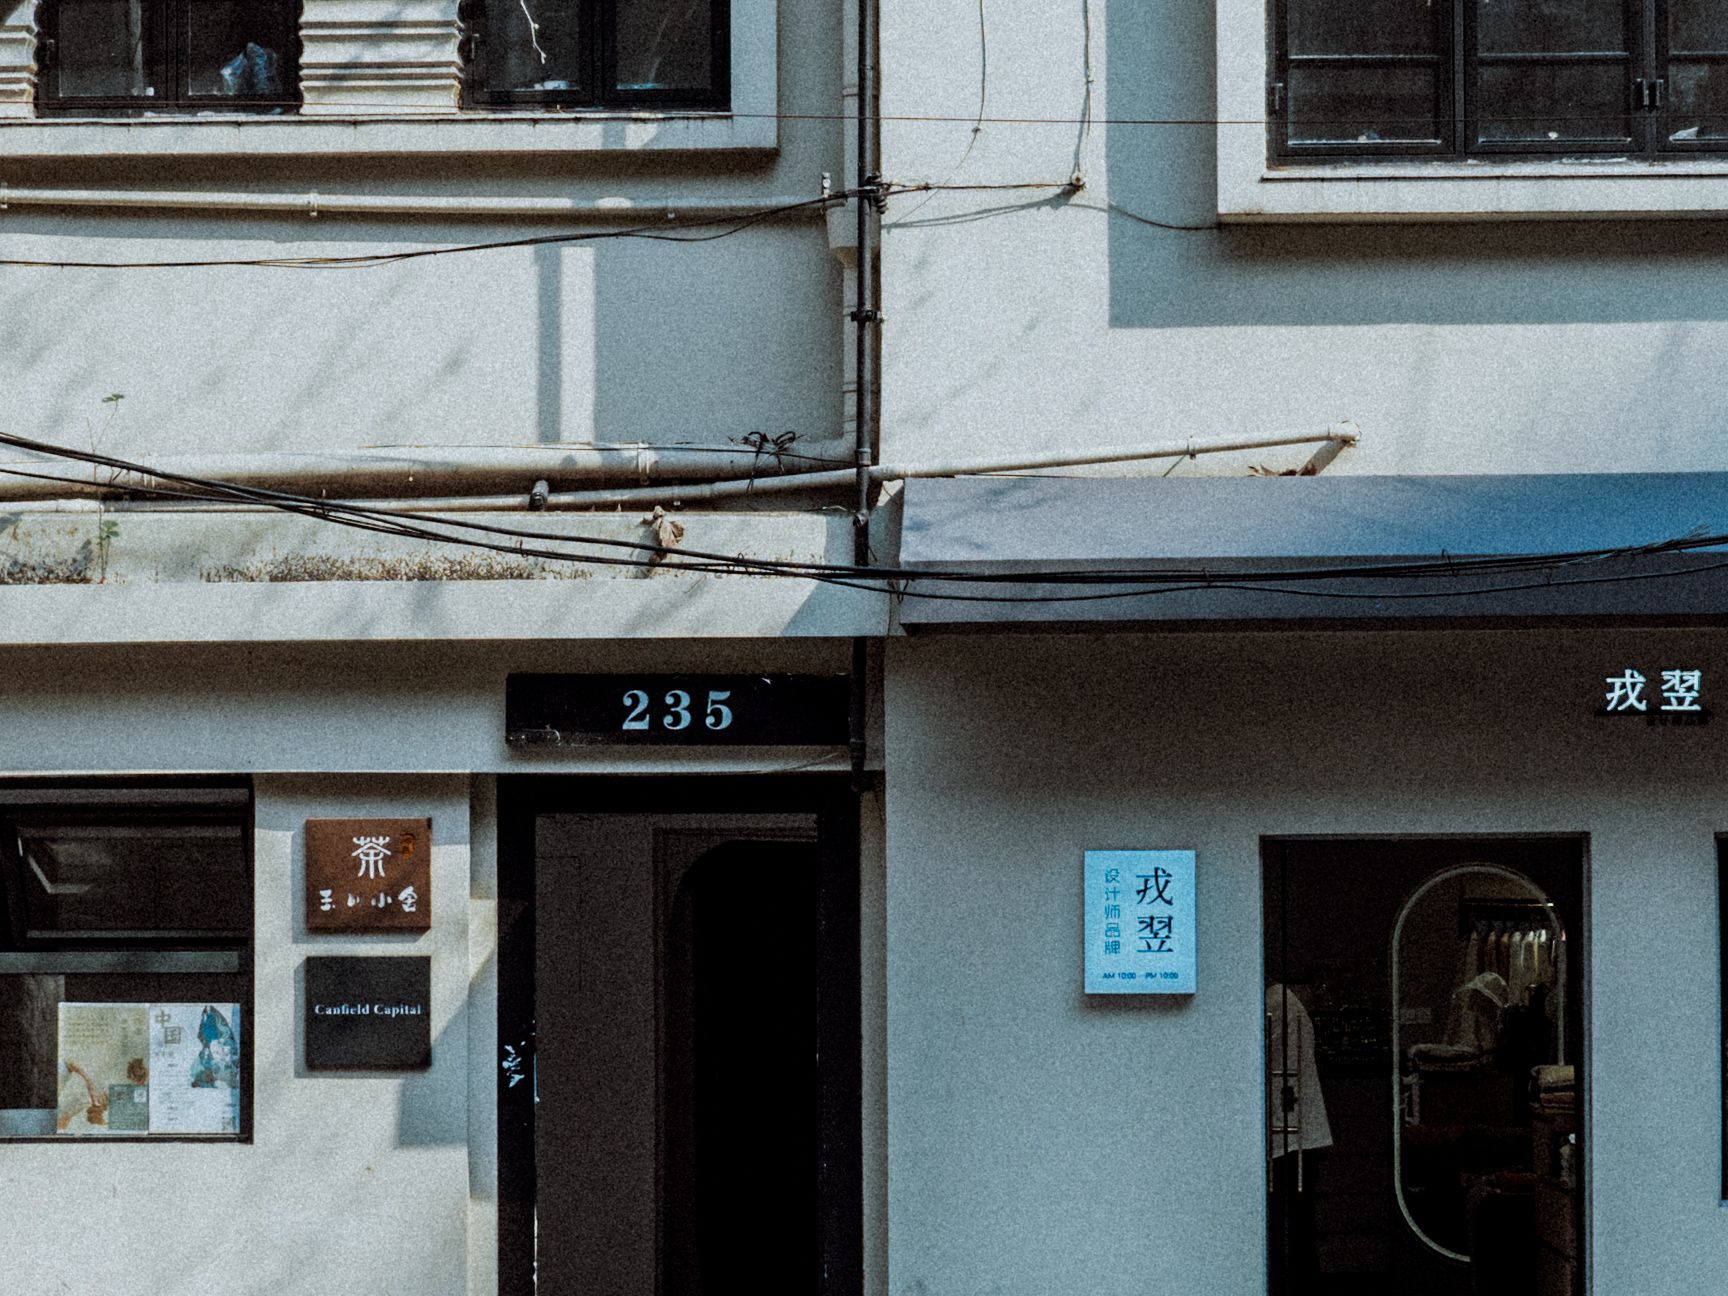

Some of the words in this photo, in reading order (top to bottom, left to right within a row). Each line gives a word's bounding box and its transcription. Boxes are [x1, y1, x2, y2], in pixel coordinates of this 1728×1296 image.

[622, 689, 733, 730] 235
[1605, 668, 1702, 712] 戎翌
[351, 836, 392, 880] 茶
[1104, 868, 1121, 955] 设计师品牌
[1135, 866, 1174, 953] 戎翌
[314, 1003, 370, 1015] Canfield
[373, 1003, 422, 1018] Capital
